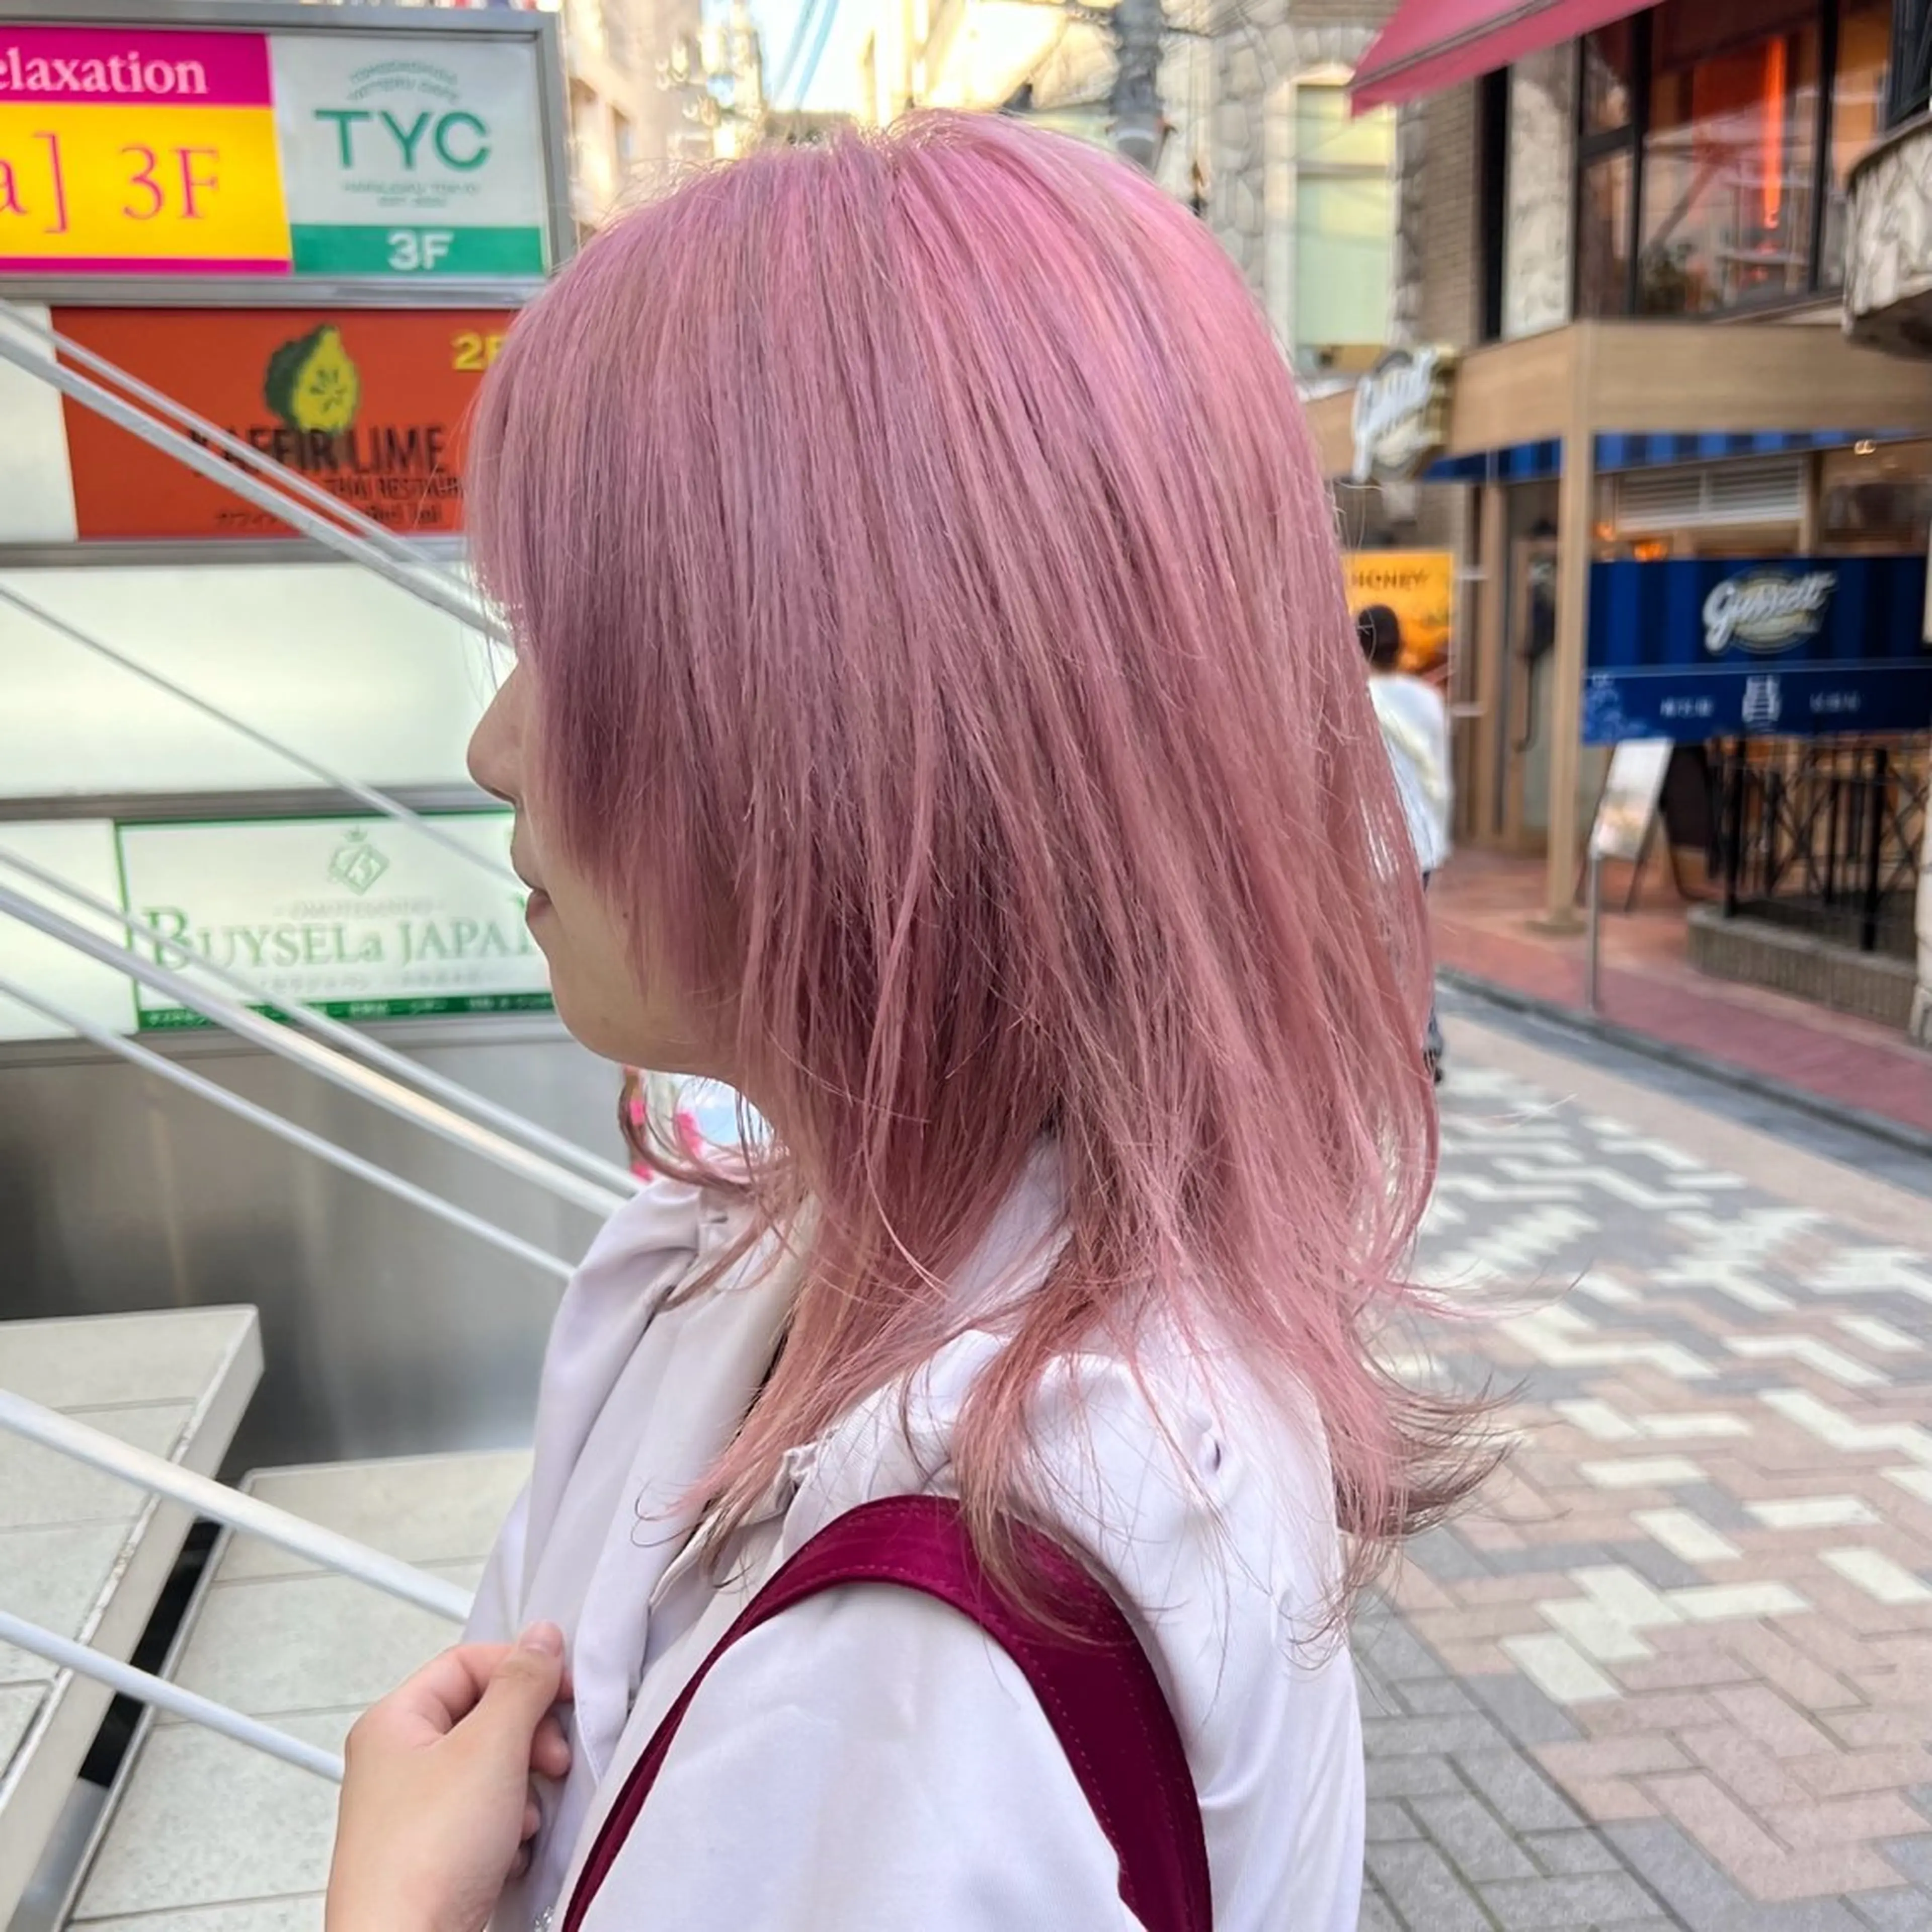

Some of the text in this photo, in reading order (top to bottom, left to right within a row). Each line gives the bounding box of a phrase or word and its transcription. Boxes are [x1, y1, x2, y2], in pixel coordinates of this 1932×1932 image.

[314, 109, 490, 172] TYC
[120, 145, 220, 220] 3F
[388, 230, 454, 270] 3F
[348, 425, 445, 474] LIME
